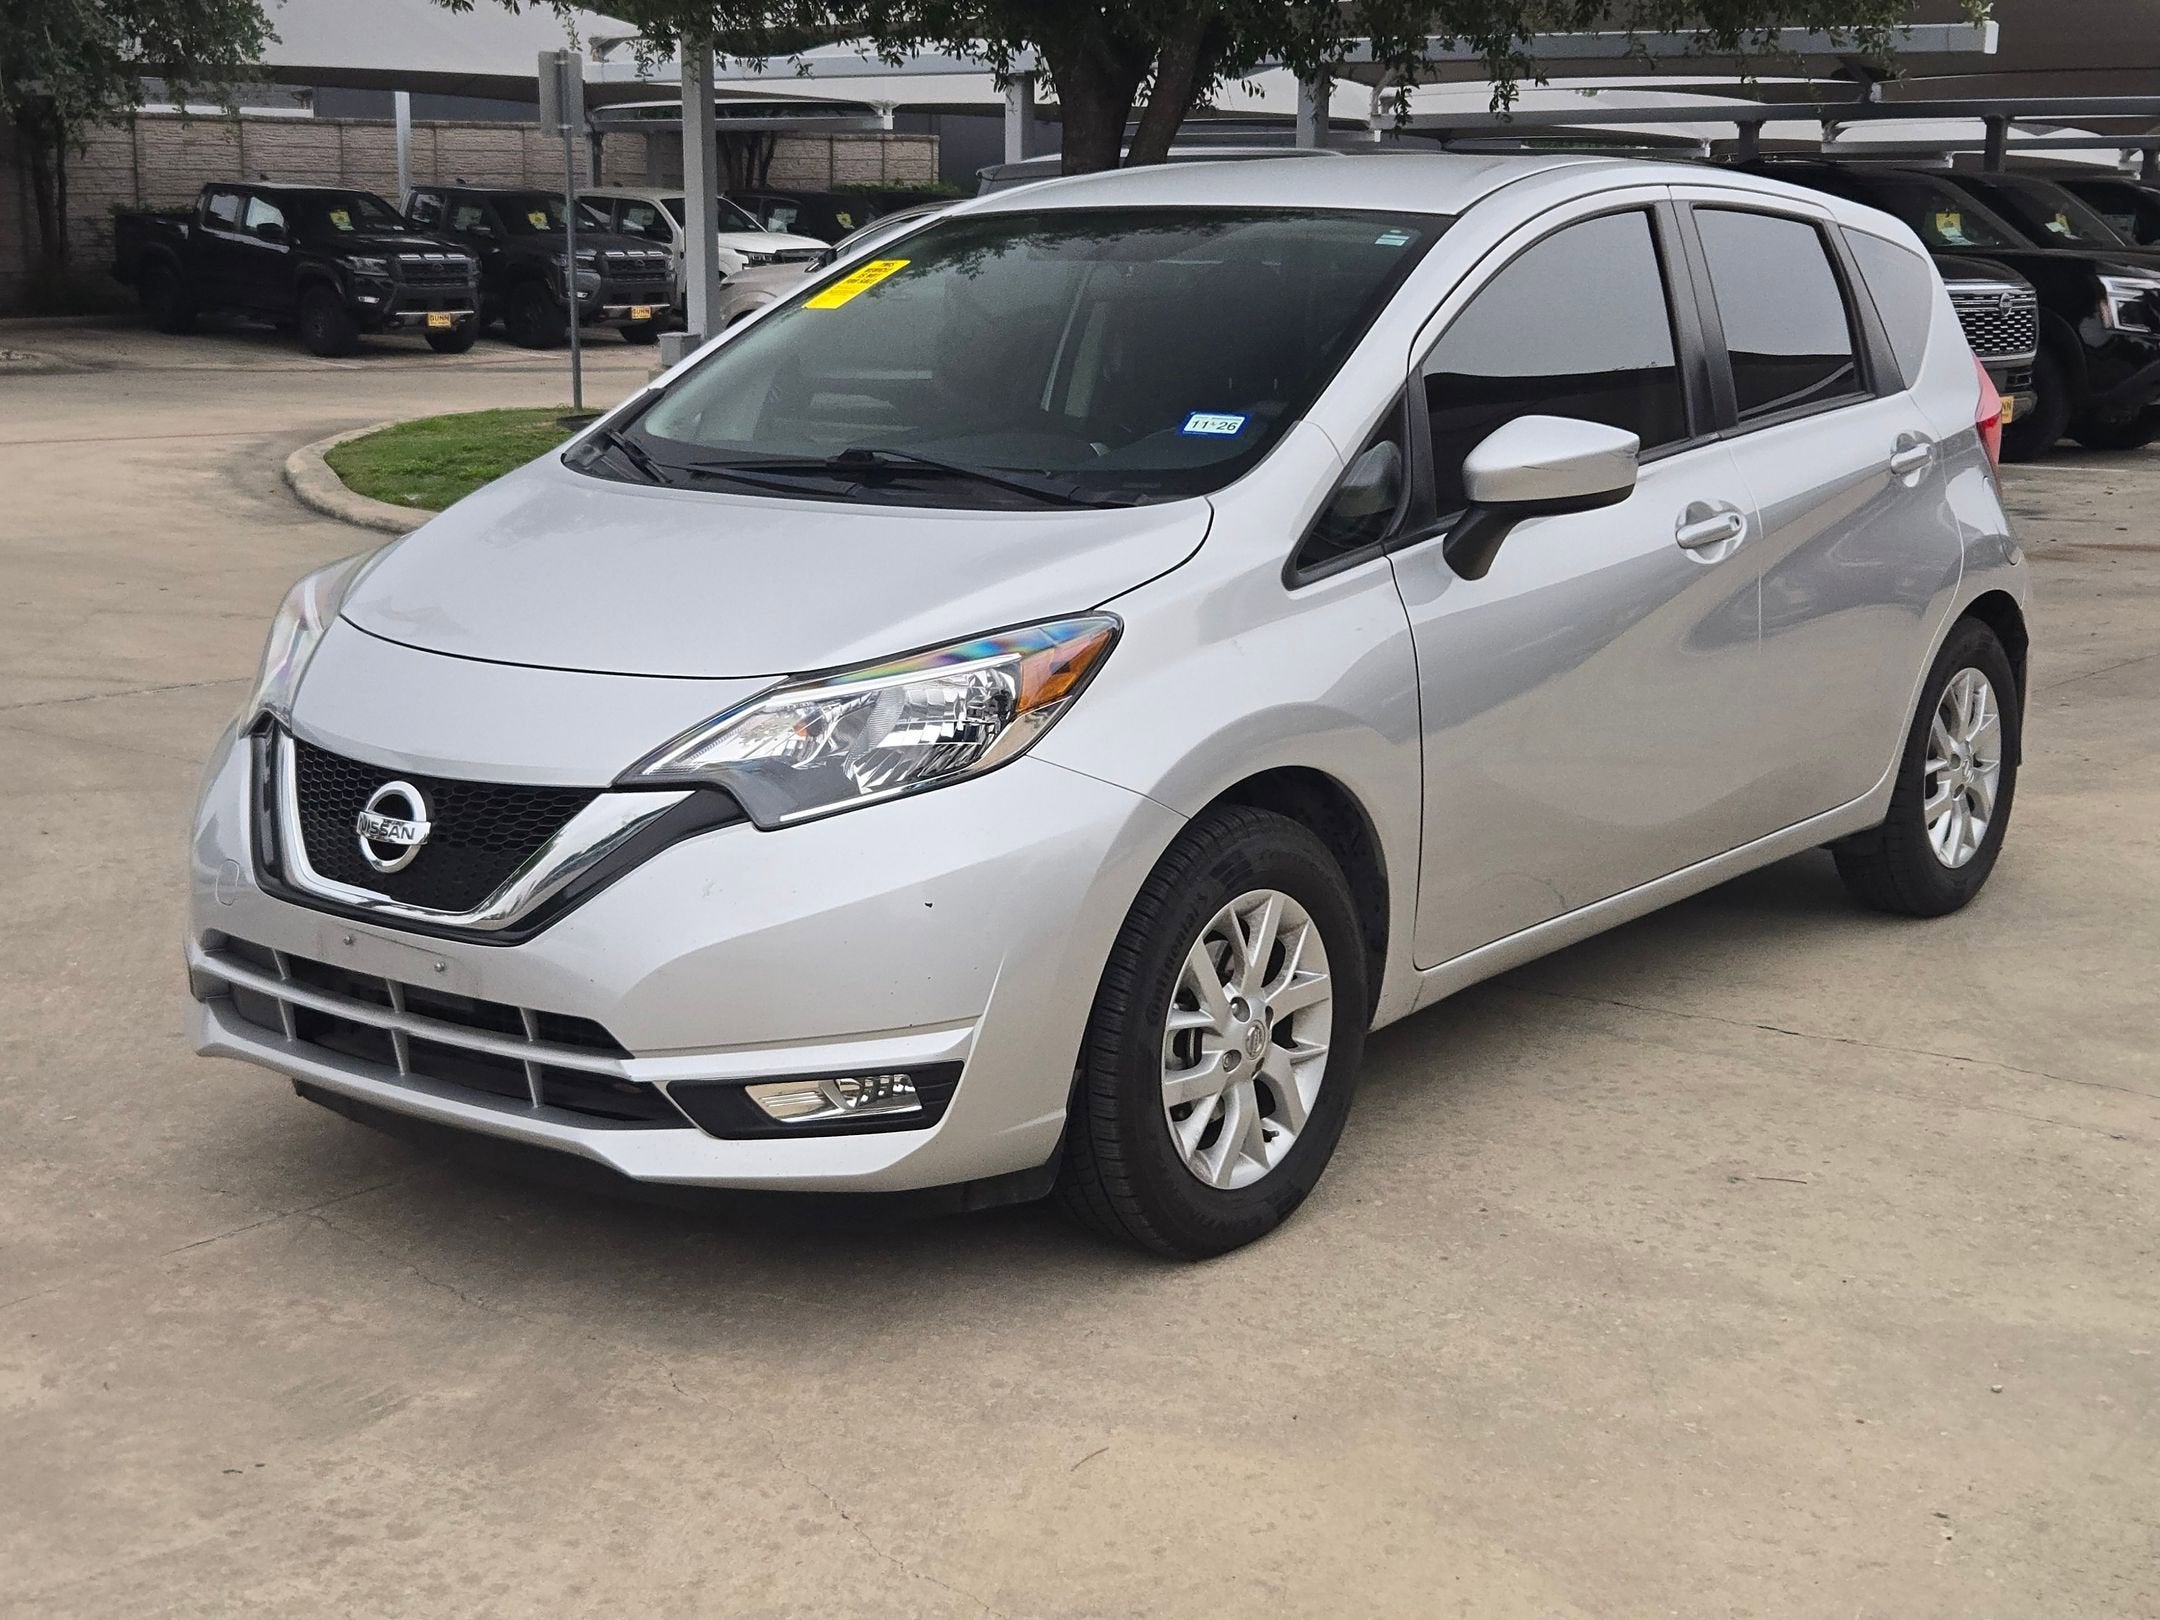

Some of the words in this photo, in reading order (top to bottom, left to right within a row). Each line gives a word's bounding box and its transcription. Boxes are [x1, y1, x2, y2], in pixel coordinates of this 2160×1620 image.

[1192, 420, 1209, 429] 11
[1216, 421, 1238, 431] 26
[360, 814, 415, 840] NISSAN
